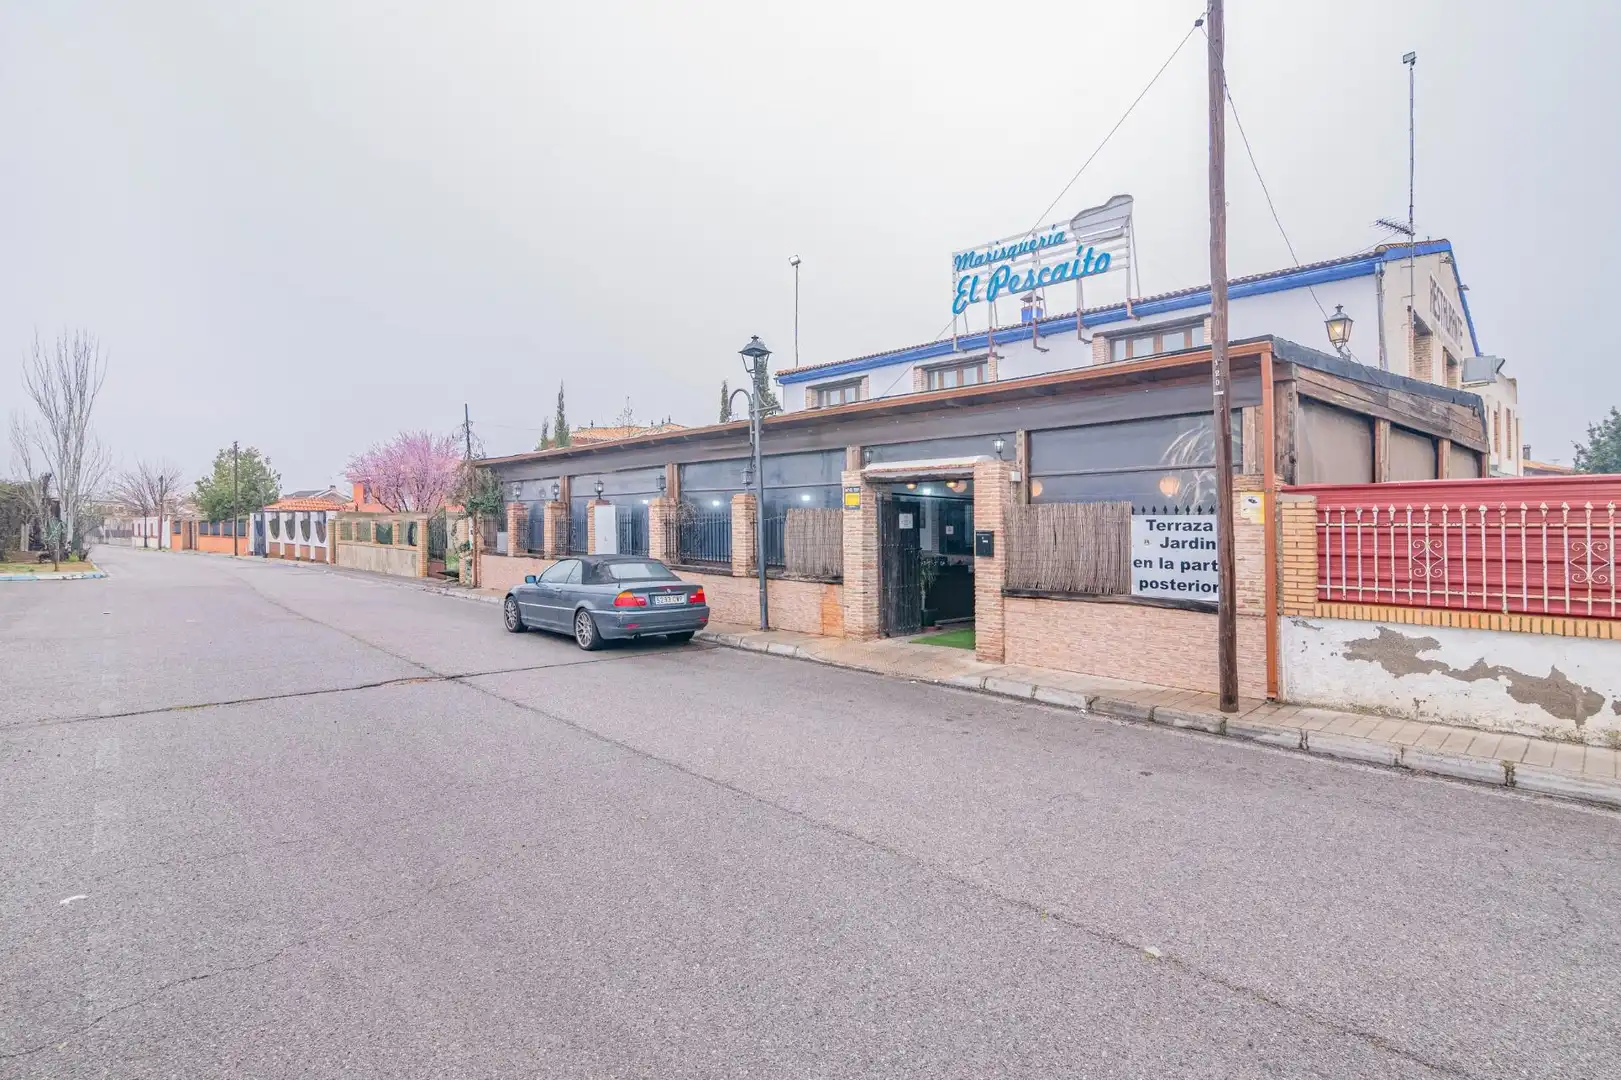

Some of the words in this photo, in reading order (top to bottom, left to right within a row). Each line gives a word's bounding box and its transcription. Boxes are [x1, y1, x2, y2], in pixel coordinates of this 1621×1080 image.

[952, 275, 980, 315] El
[1145, 519, 1214, 532] Terraza
[1160, 537, 1217, 550] Jardin
[1133, 559, 1153, 568] en
[1159, 557, 1174, 570] la
[1180, 560, 1218, 573] part
[1139, 579, 1219, 593] posterior
